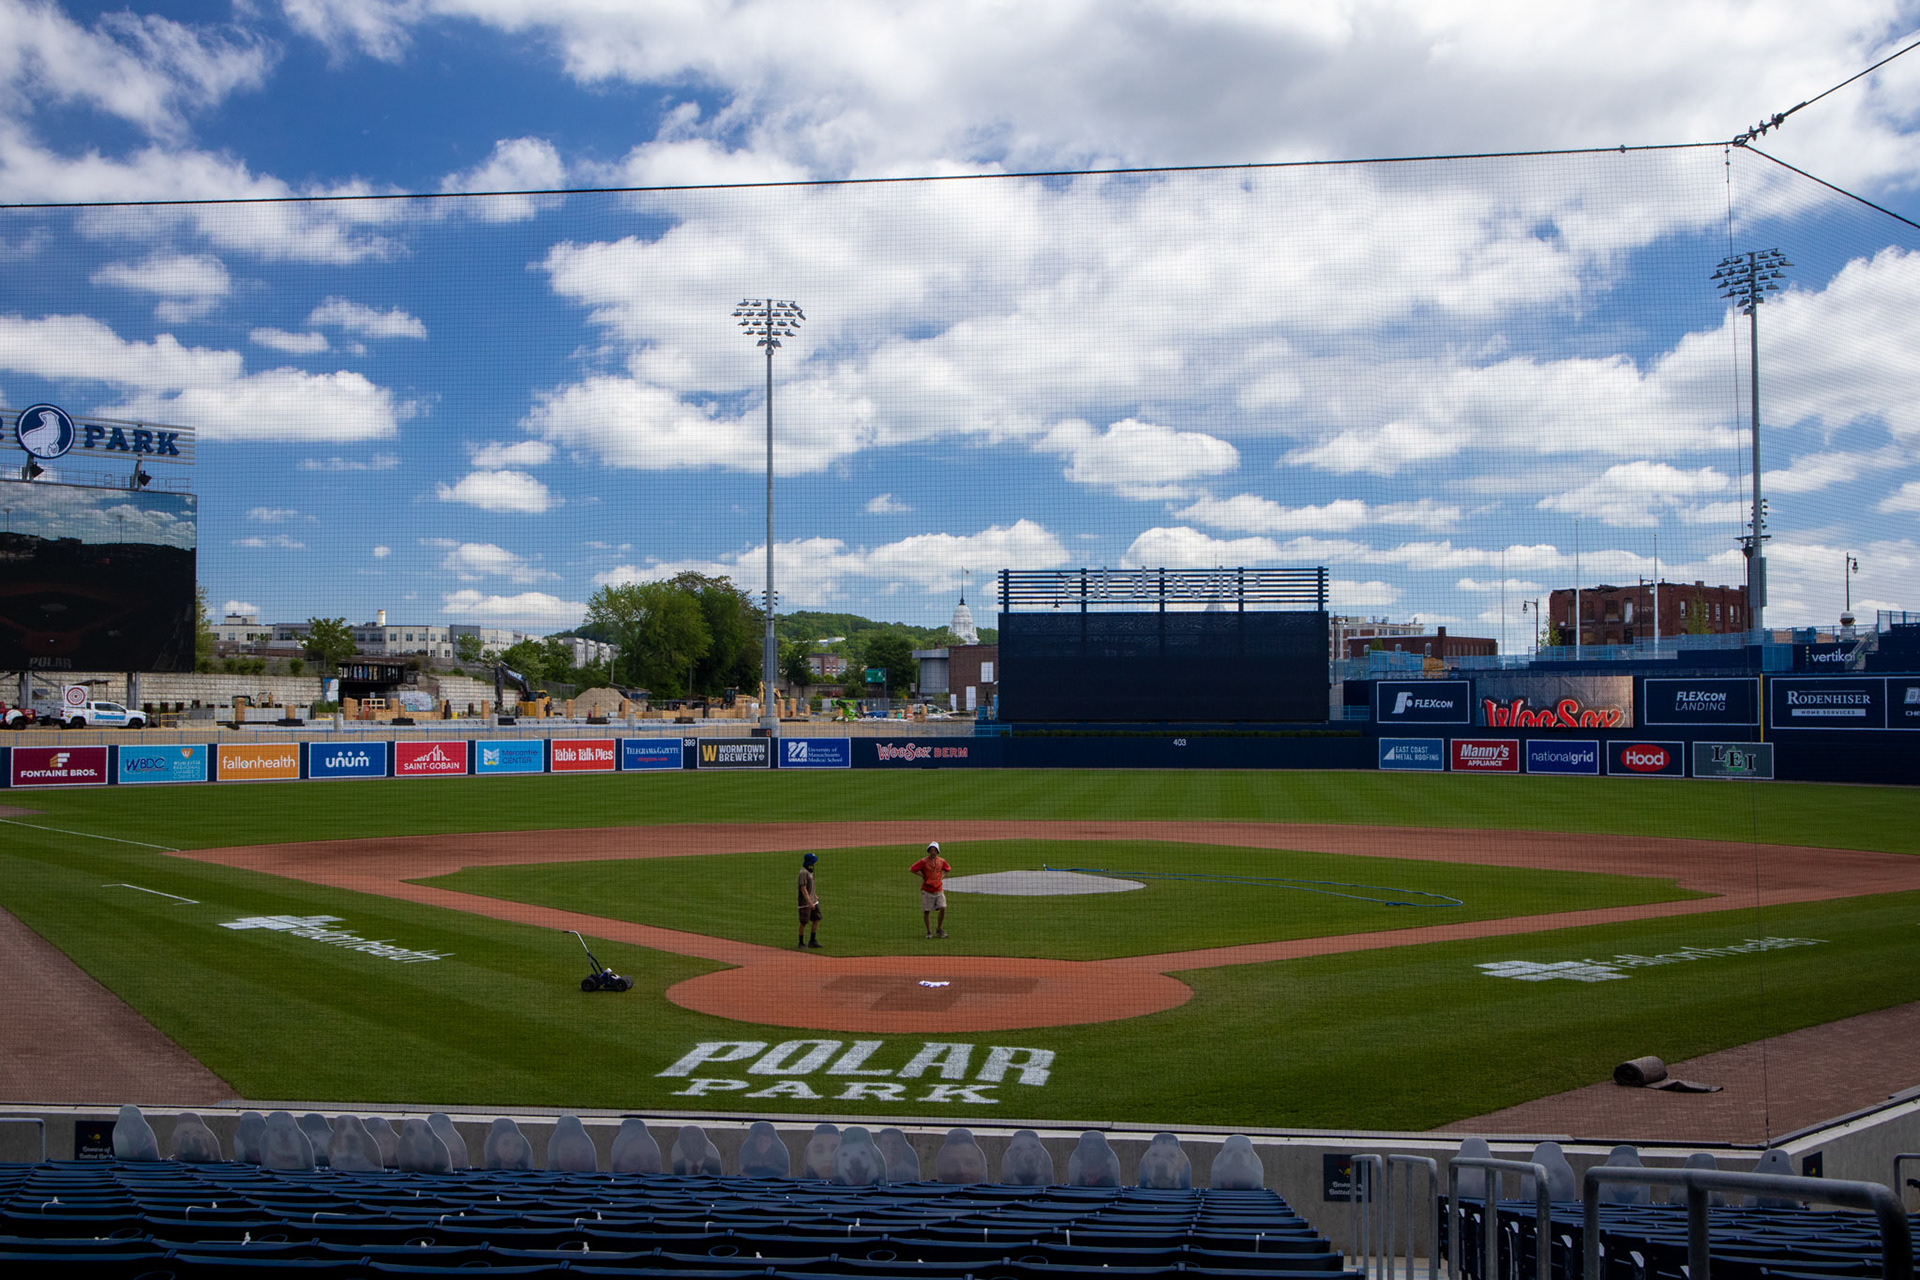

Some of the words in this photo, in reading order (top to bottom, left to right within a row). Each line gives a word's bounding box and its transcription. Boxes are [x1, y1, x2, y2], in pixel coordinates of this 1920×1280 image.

[84, 424, 181, 456] PARK
[1064, 566, 1261, 600] abbvie
[28, 656, 73, 669] POLAR
[1786, 690, 1871, 705] RODENHISER
[1675, 702, 1726, 711] LANDING
[683, 738, 696, 747] 399
[718, 744, 766, 753] WORMTOWN
[1172, 738, 1187, 747] 403
[1395, 745, 1409, 753] EAST
[554, 748, 577, 762] Table
[578, 747, 595, 762] Talk
[596, 748, 613, 761] Pies
[718, 753, 759, 762] BREWERY
[934, 747, 968, 759] BERM
[1460, 744, 1509, 759] Manny's
[1531, 750, 1594, 764] nationalgrid
[1626, 751, 1664, 765] Hood
[126, 757, 165, 771] WBDC
[222, 755, 296, 770] fallonhealth
[404, 761, 460, 771] SAINT-GOBAIN
[502, 756, 532, 764] CENTER
[20, 769, 68, 778] FONTAINE
[70, 768, 97, 777] BROS.
[654, 1039, 1056, 1086] POLAR
[669, 1078, 1001, 1105] PARK
